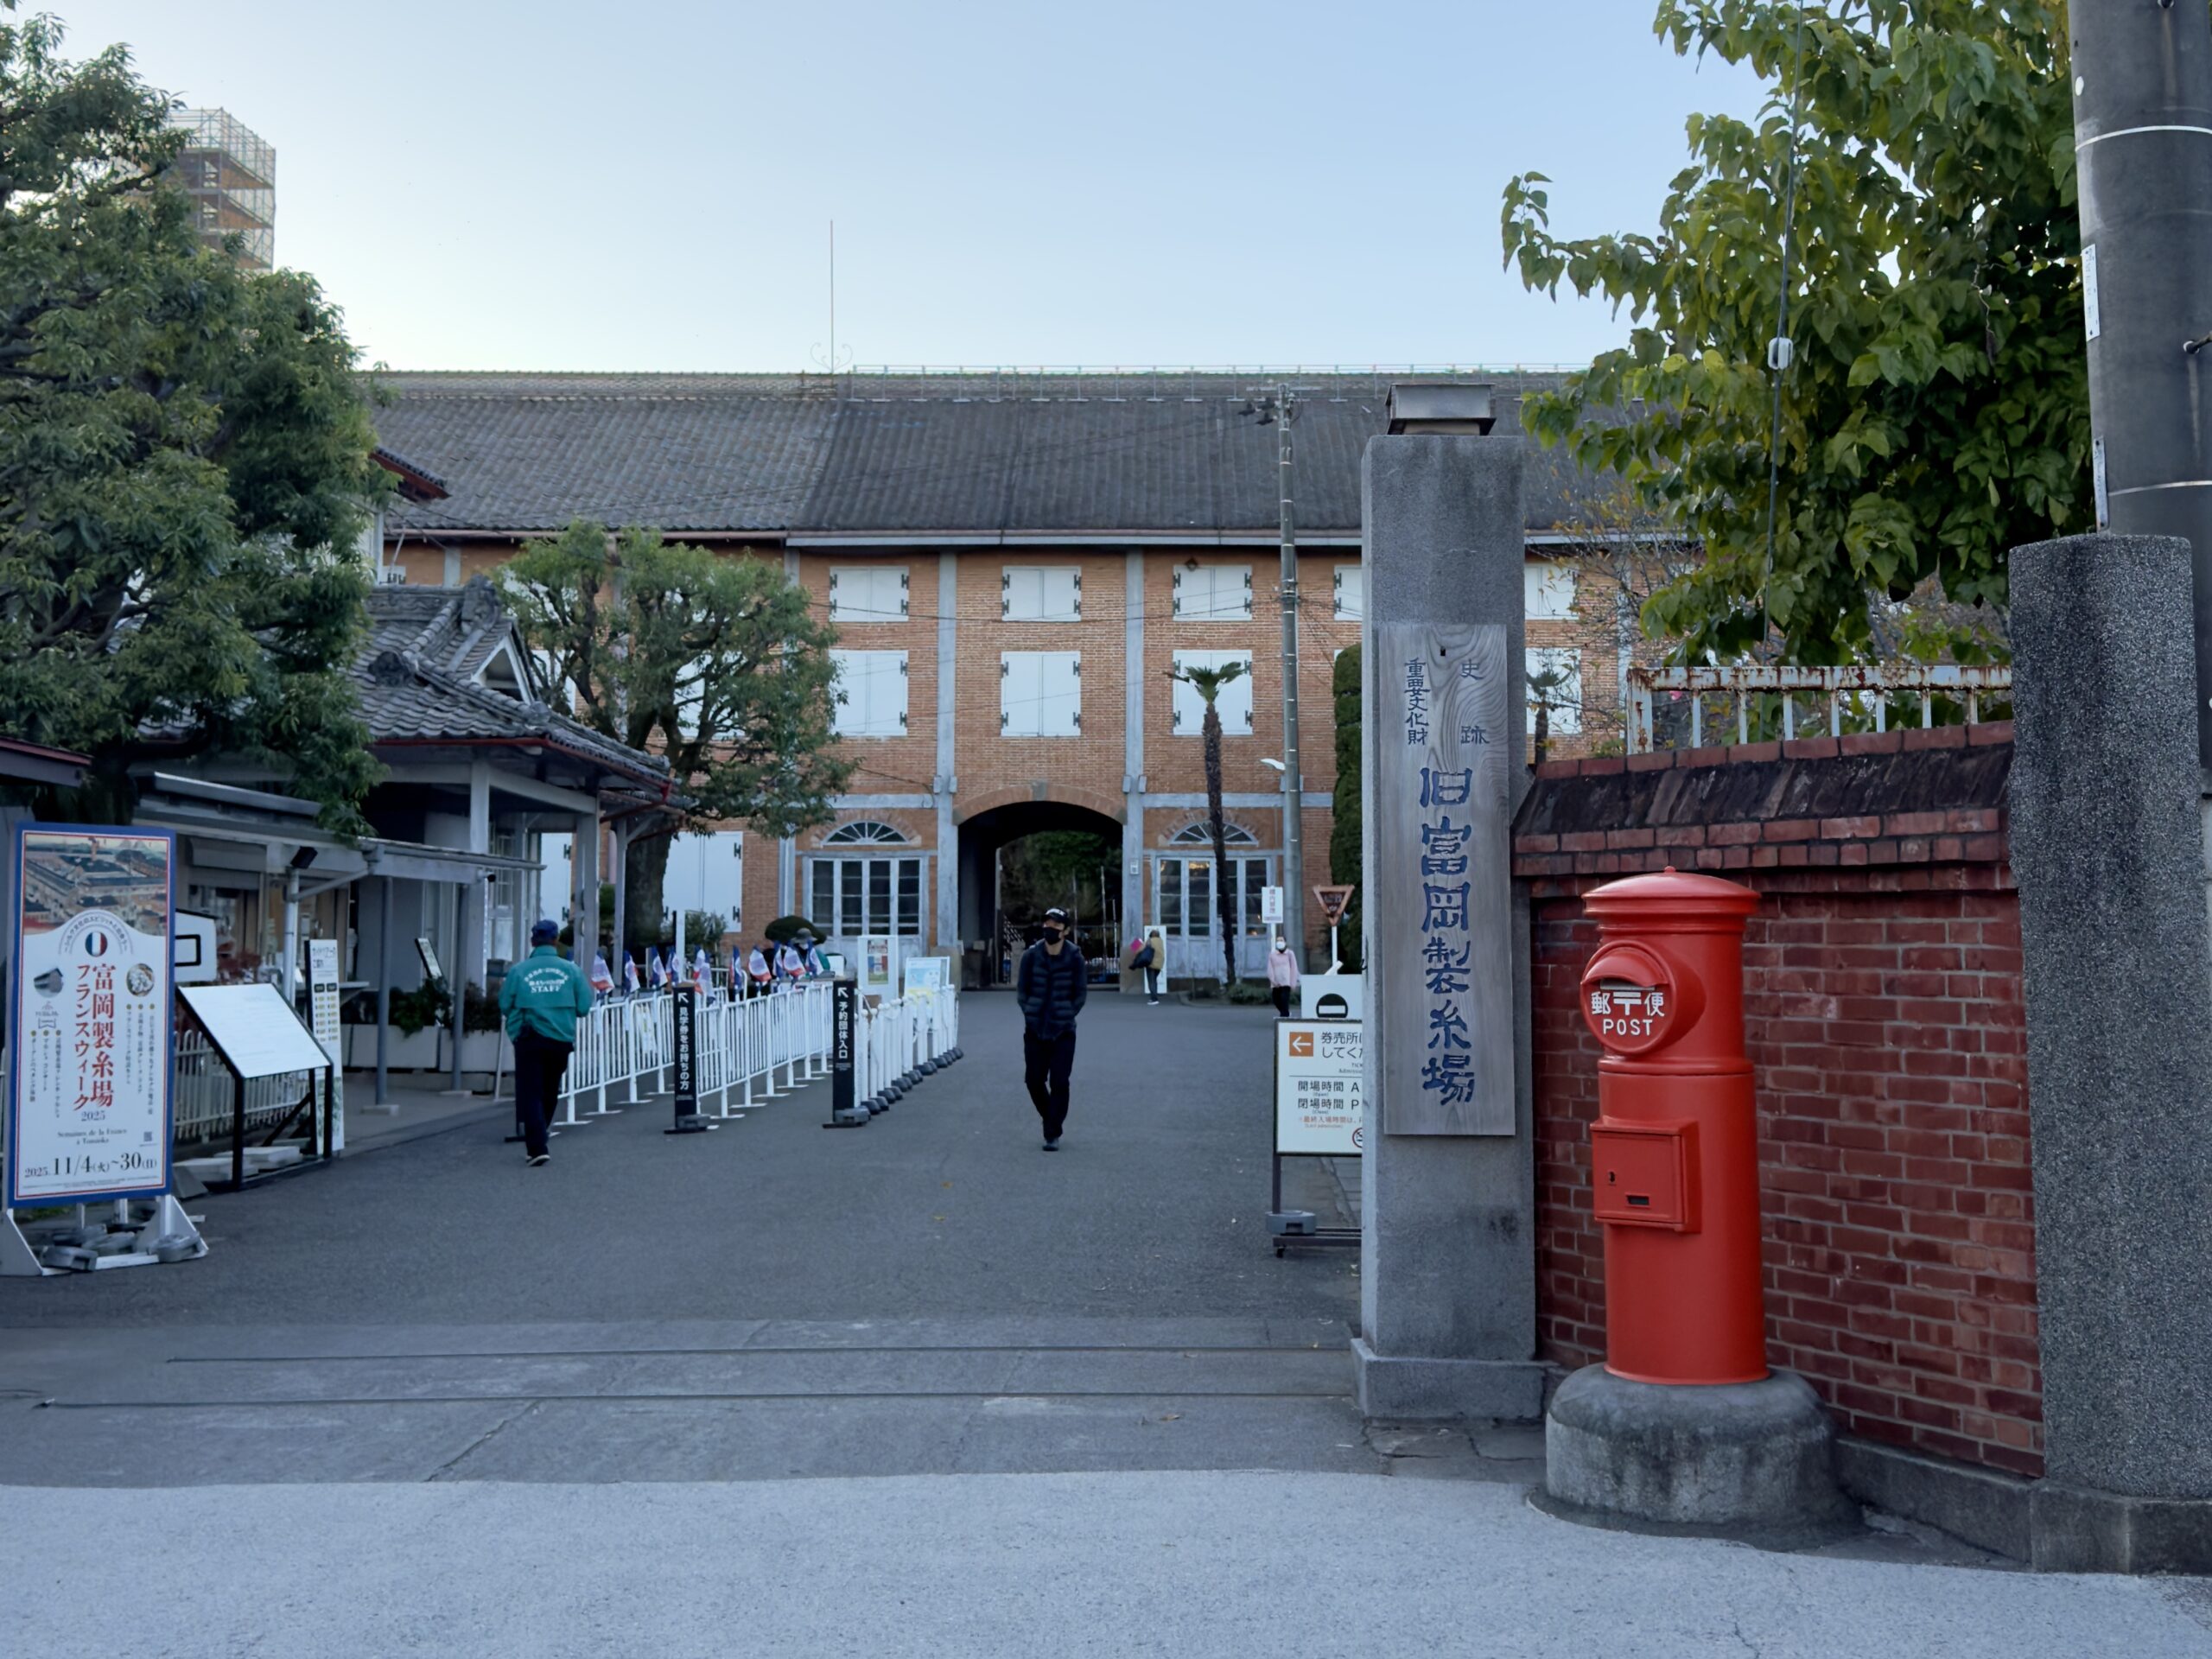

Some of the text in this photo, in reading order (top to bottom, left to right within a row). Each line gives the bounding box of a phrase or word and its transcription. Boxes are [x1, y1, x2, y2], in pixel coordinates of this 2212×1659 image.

[1403, 657, 1431, 746] 重要文化財
[1419, 766, 1476, 1107] 旧富岡製糸場
[531, 984, 562, 994] STAFF
[73, 963, 91, 1112] フランスウィーク
[91, 963, 117, 1109] 富岡製糸場
[679, 1007, 690, 1090] 見学券をお持ちの方
[838, 1001, 849, 1059] 予約団体入口
[1603, 1018, 1653, 1036] POST
[1298, 1080, 1360, 1093] 開場時間 A
[1298, 1097, 1359, 1110] 閉場時間 P
[81, 1110, 105, 1122] 2025
